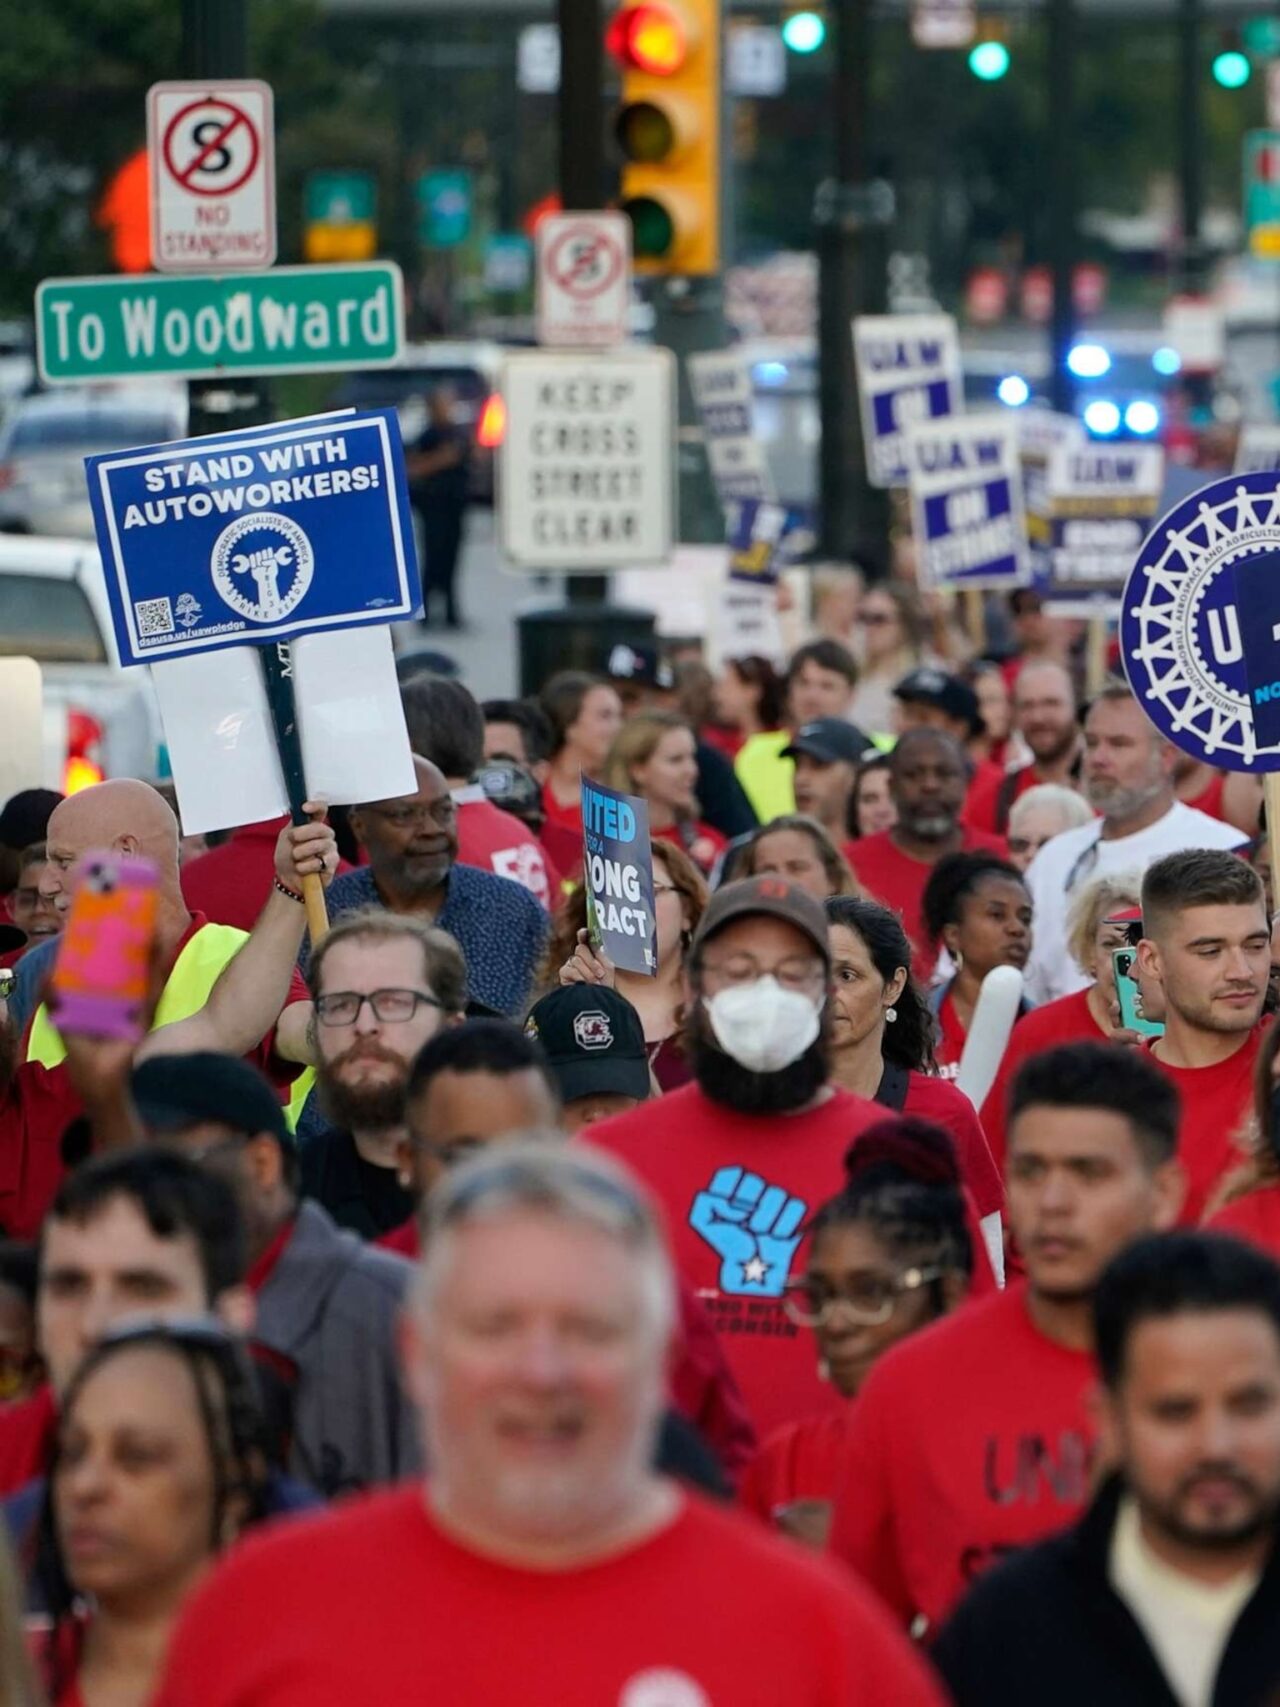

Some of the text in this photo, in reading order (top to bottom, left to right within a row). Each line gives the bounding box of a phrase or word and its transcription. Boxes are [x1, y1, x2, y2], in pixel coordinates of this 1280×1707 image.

[195, 205, 230, 226] NO
[165, 233, 263, 252] STANDING
[50, 285, 390, 362] To Woodward
[868, 340, 943, 371] UAW
[536, 378, 634, 411] KEEP
[532, 423, 641, 456] CROSS
[917, 439, 1003, 472] UAW
[144, 437, 348, 492] STAND WITH
[123, 463, 380, 529] AUTOWORKERS!
[531, 464, 643, 500] STREET
[236, 516, 282, 532] SOCIALISTS
[291, 530, 309, 565] AMERICA
[532, 510, 640, 544] CLEAR
[1203, 546, 1225, 565] AND
[226, 587, 270, 619] STRIKE
